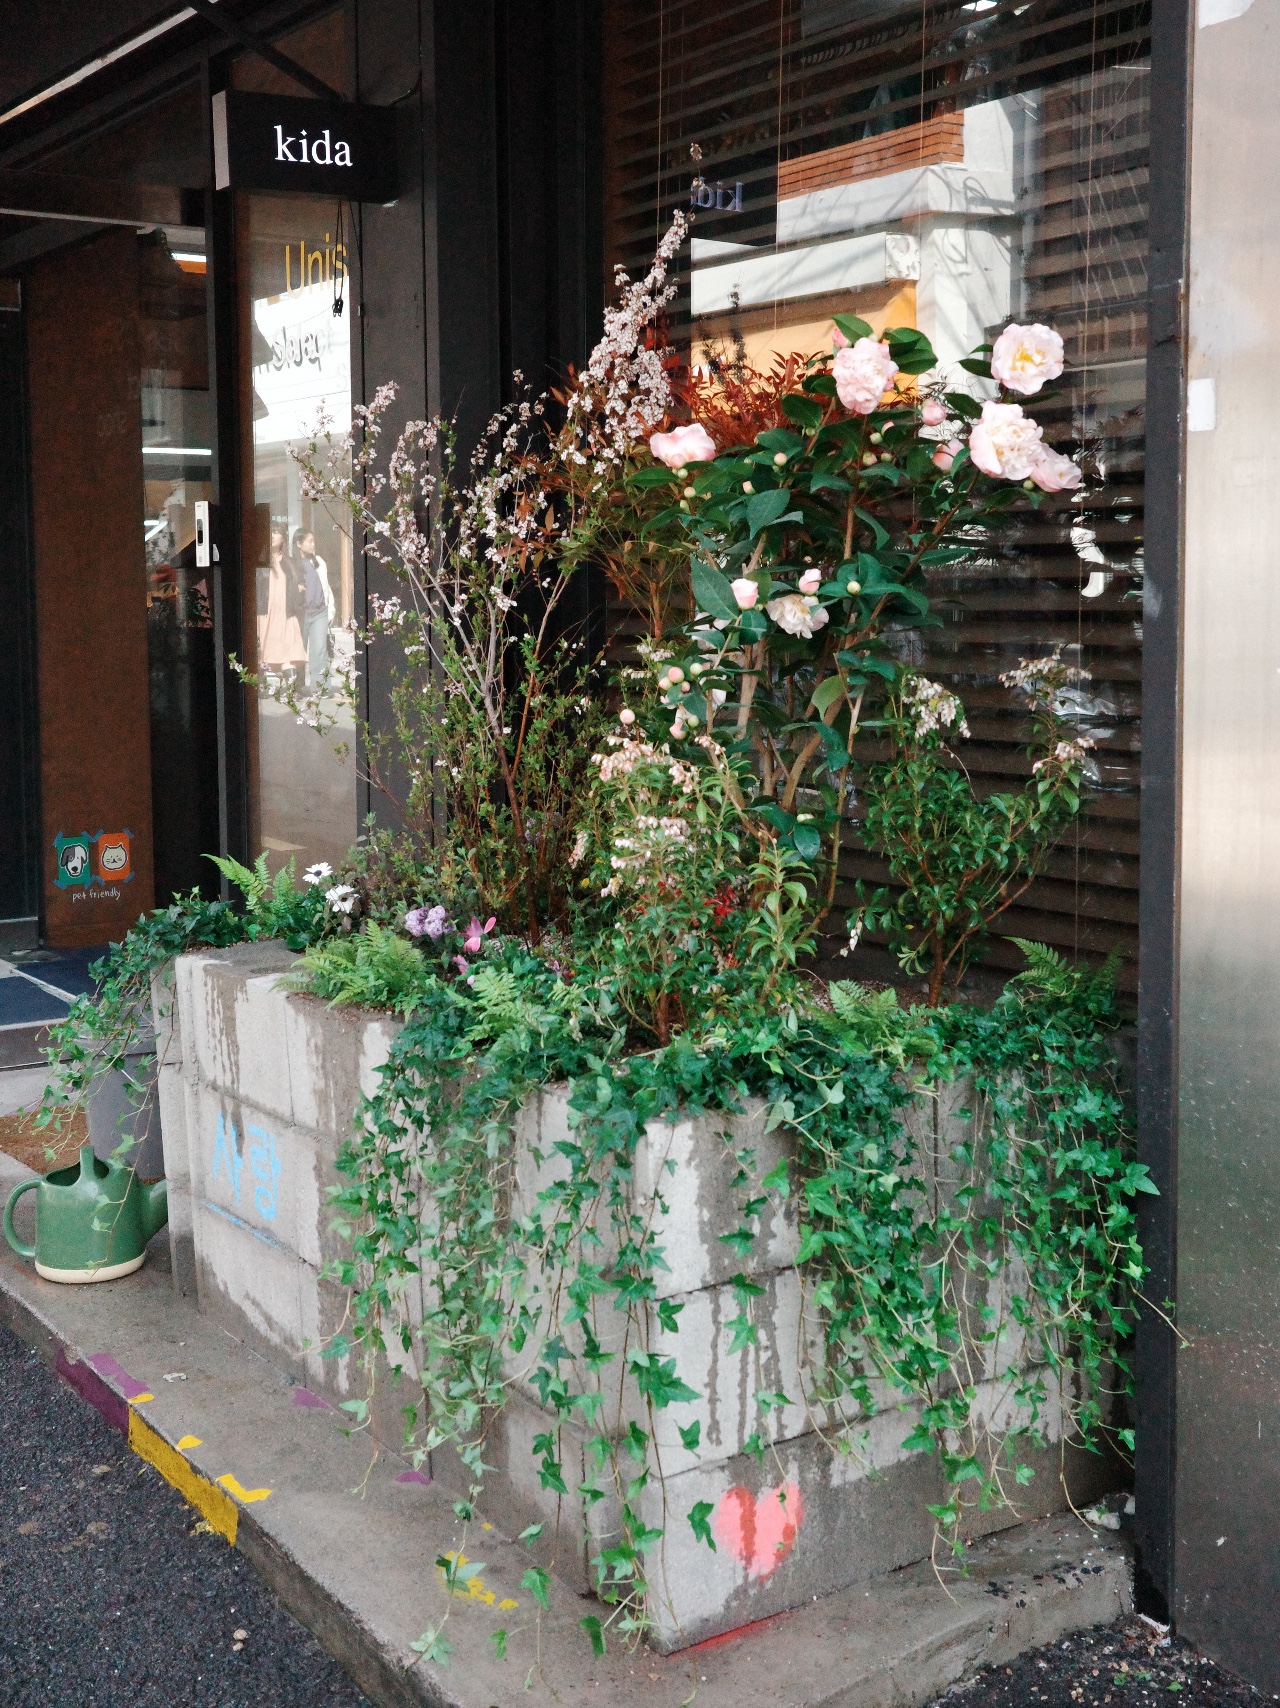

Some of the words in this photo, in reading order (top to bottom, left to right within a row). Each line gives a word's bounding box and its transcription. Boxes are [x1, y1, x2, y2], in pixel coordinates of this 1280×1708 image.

[273, 125, 353, 167] kida
[285, 233, 347, 299] Unis
[72, 890, 87, 903] pet
[89, 887, 121, 901] friendly
[213, 1110, 282, 1221] 사랑
